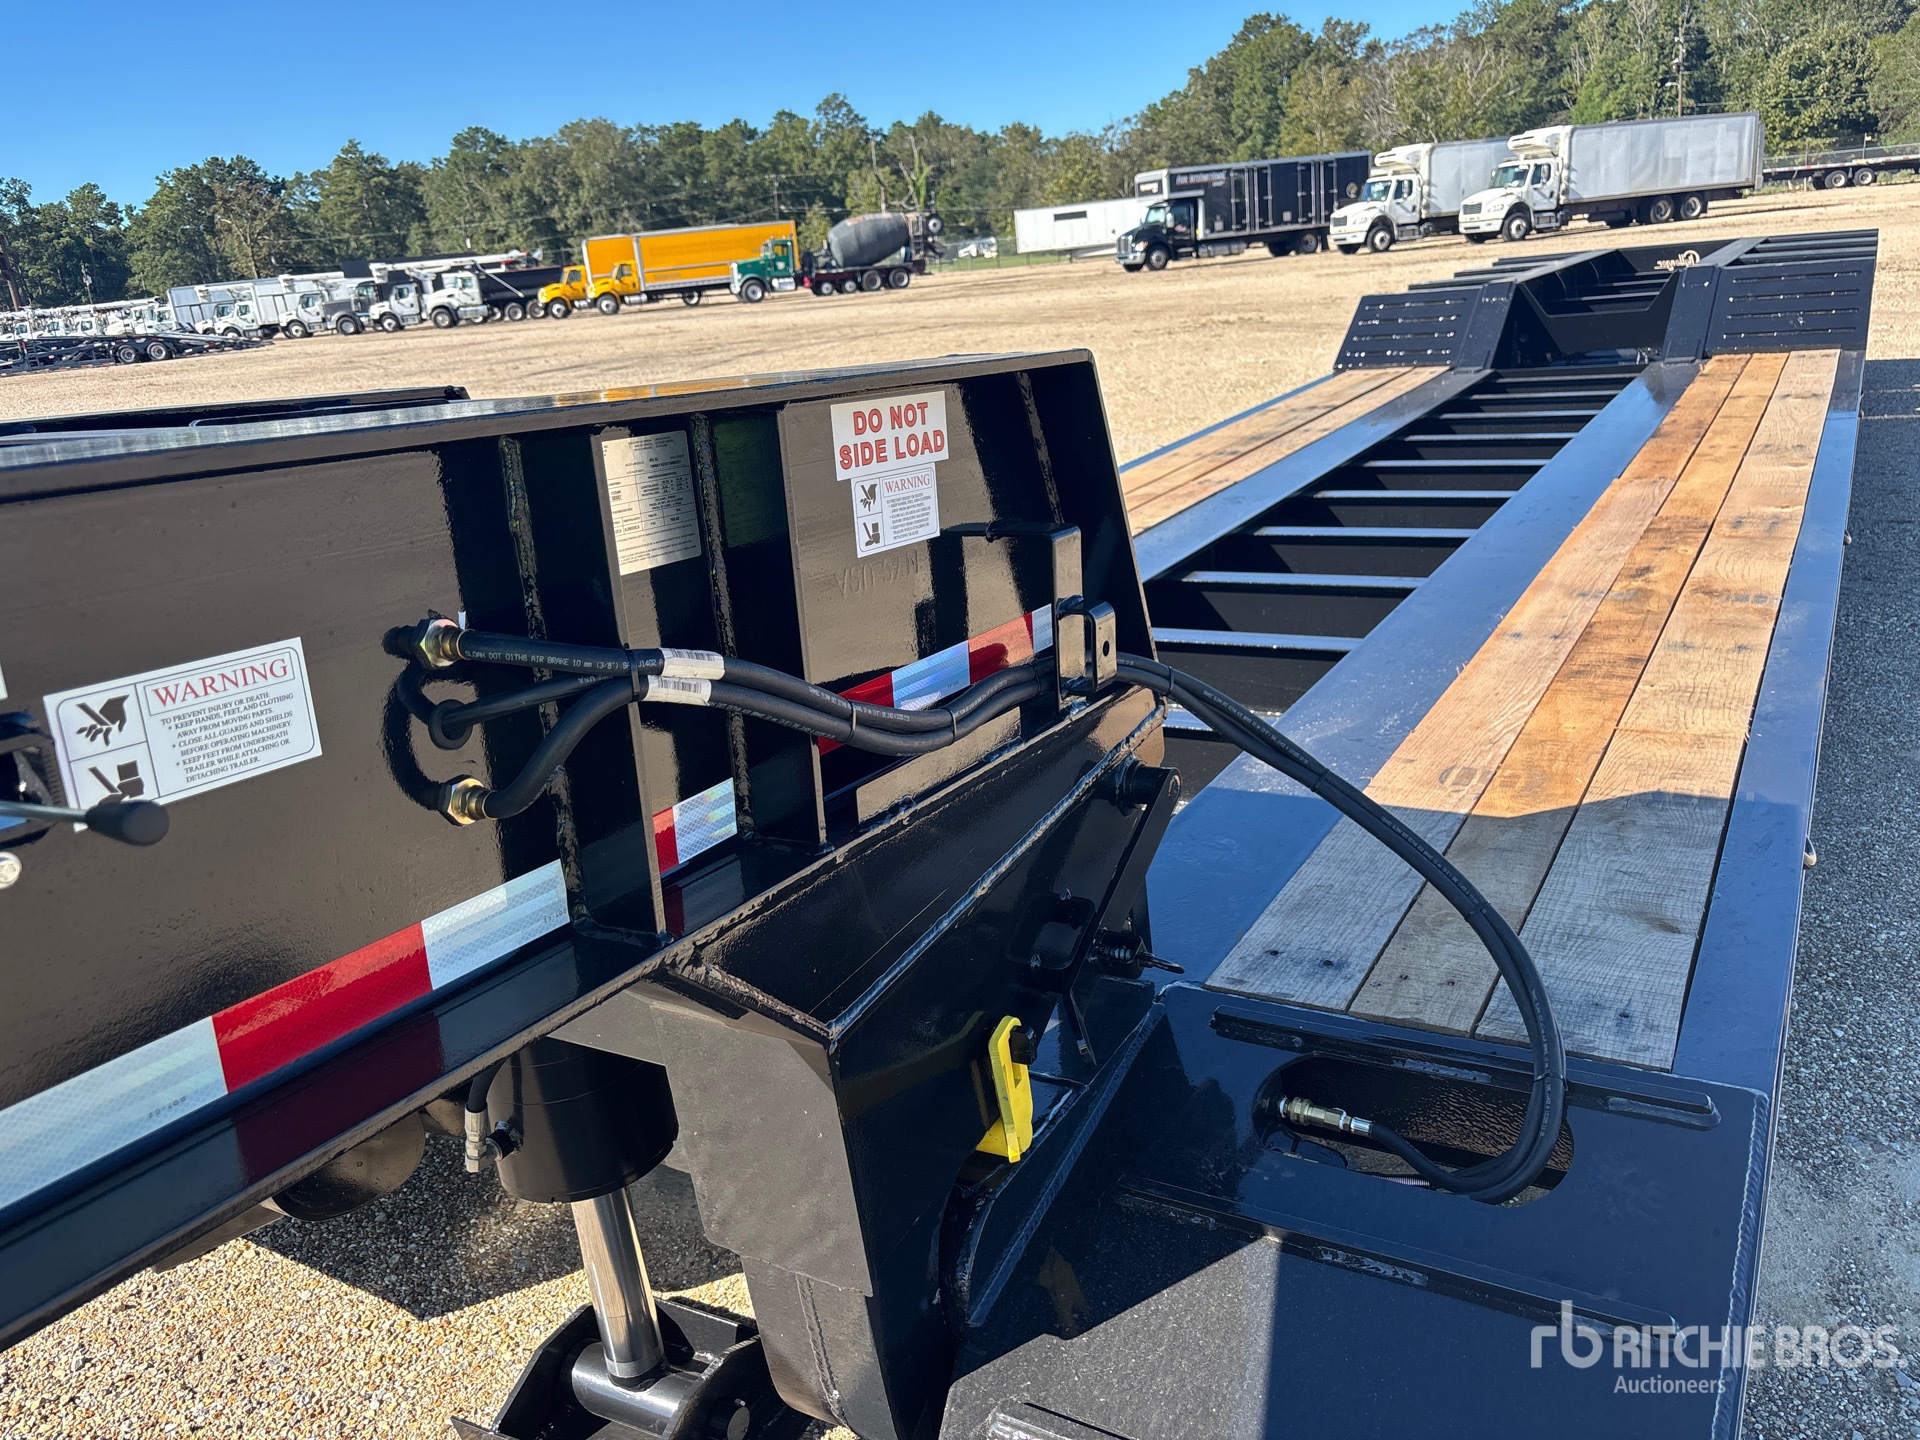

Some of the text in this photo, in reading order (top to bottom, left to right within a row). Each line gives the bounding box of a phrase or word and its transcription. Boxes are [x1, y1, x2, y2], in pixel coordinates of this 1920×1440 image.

[853, 402, 928, 436] DO NOT
[839, 429, 945, 470] SIDE LOAD
[885, 473, 931, 494] WARNING
[488, 652, 502, 660] DOT
[530, 655, 545, 663] AIR
[547, 656, 570, 666] BRAKE
[572, 659, 582, 667] 10
[152, 657, 288, 707] WARNING
[161, 692, 271, 726] TO PREVENT INJURY OR DEATH:
[175, 693, 294, 730] KEEP HANDS, FEET, AND CLOTHING
[177, 728, 199, 739] AWAY
[199, 722, 221, 732] FROM
[221, 714, 251, 726] MOVING
[178, 710, 293, 748] CLOSE ALL GUARDS AND SHIELDS
[180, 720, 293, 757] BEFORE OPERATING MACHINERY.
[182, 730, 288, 766] KEEP FEET FROM UNDERNEATH
[184, 738, 291, 775] TRAILER WHILE ATTACHING OR
[186, 766, 229, 783] DETACHING
